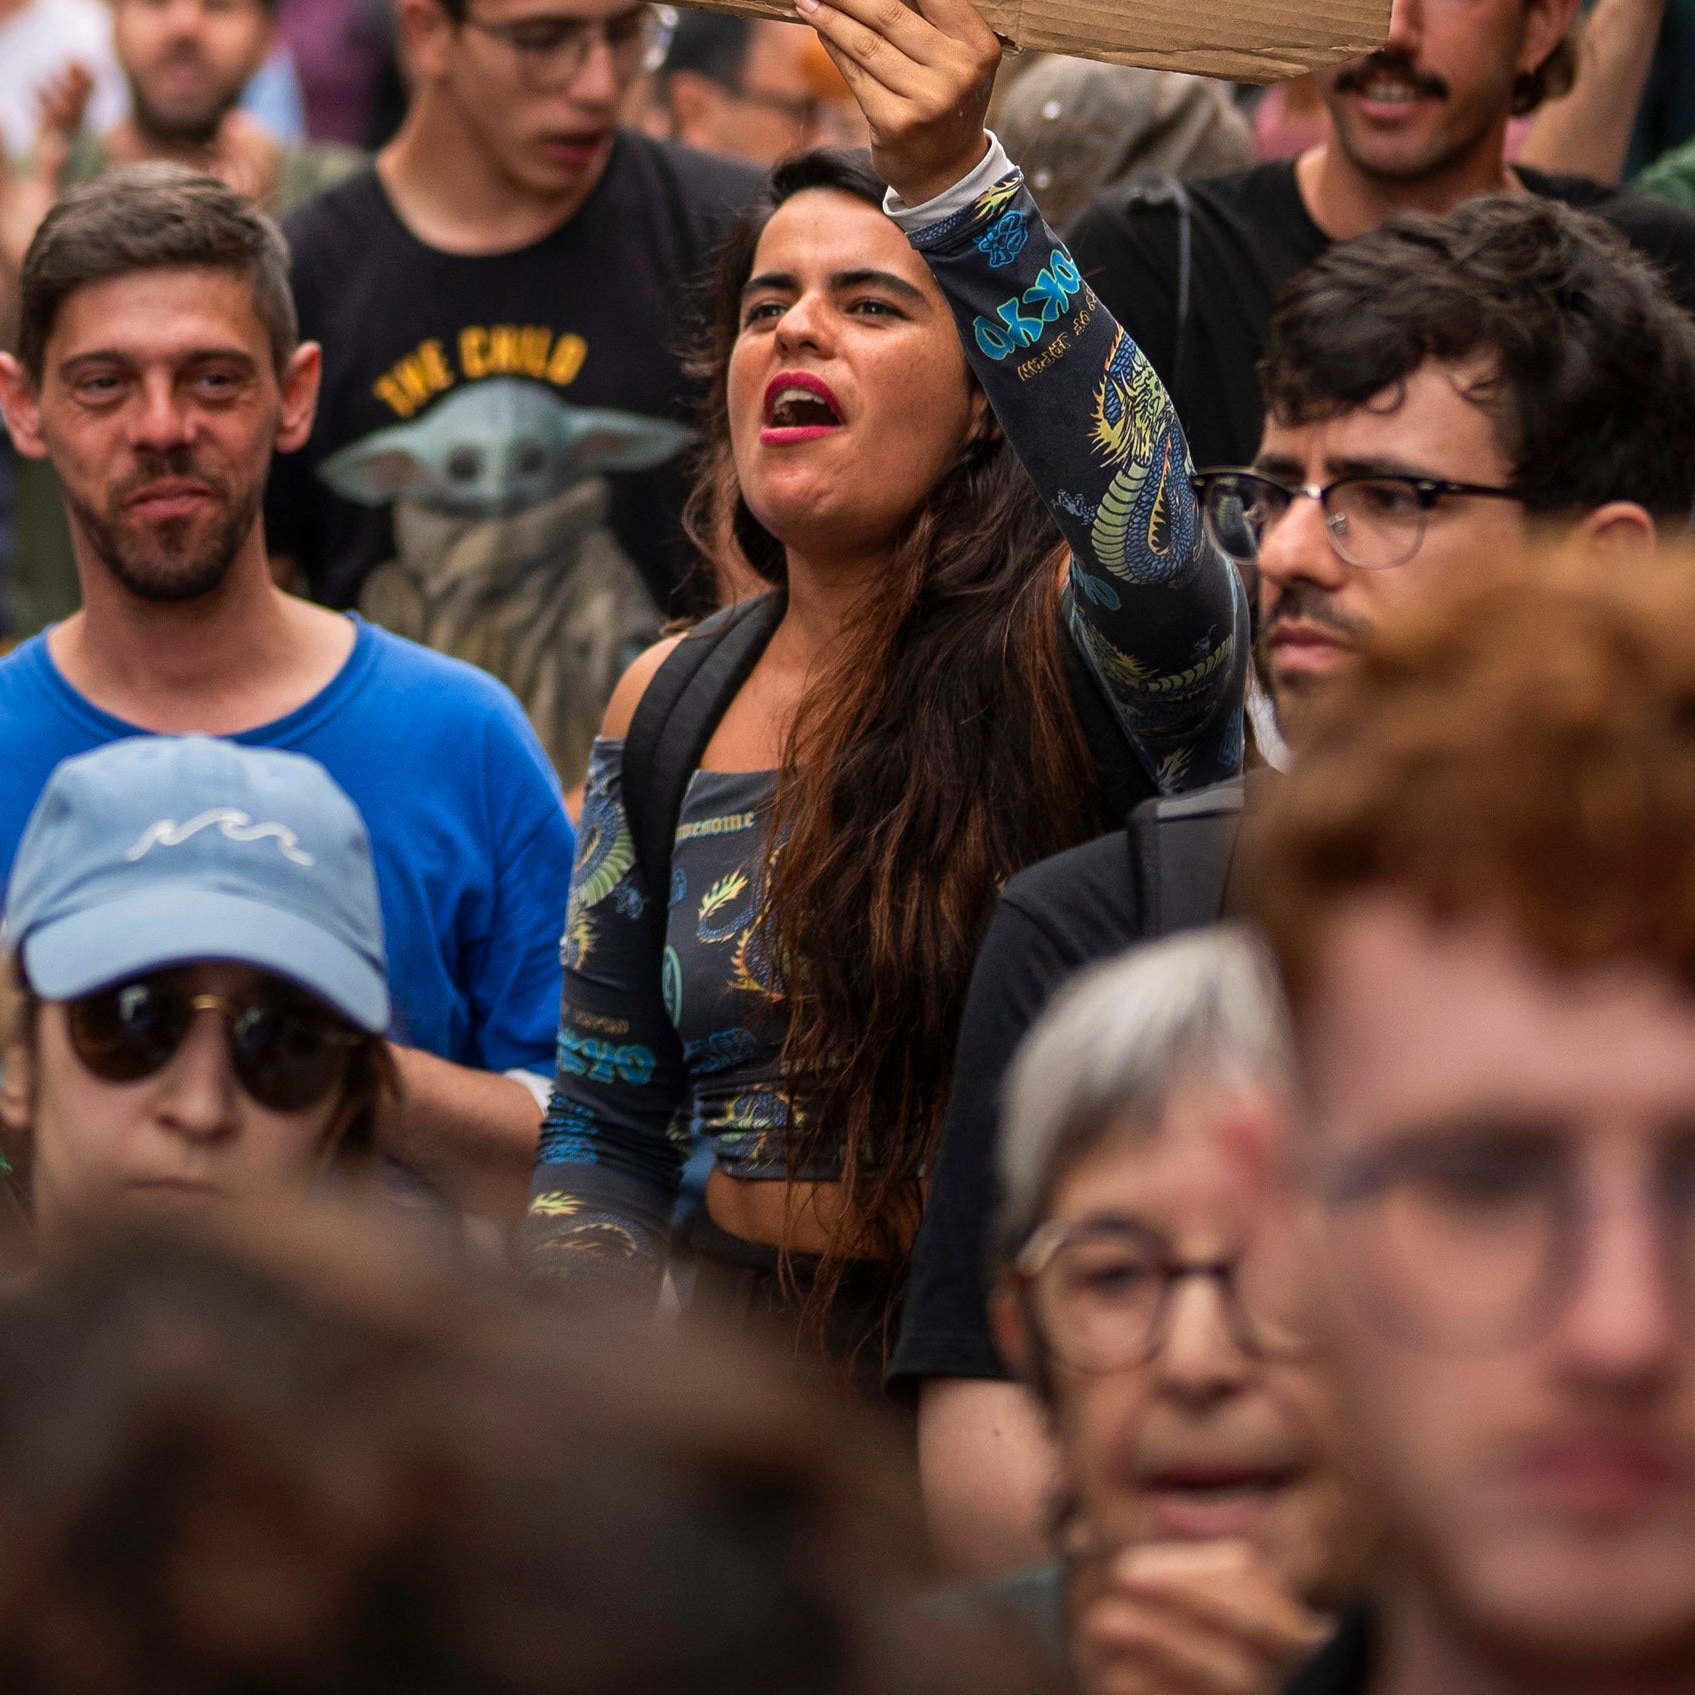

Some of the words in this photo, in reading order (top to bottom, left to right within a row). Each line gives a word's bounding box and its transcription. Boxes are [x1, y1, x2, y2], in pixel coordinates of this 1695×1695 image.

[373, 338, 455, 419] THE
[458, 323, 589, 387] CHILD
[1017, 331, 1072, 382] JAPAN
